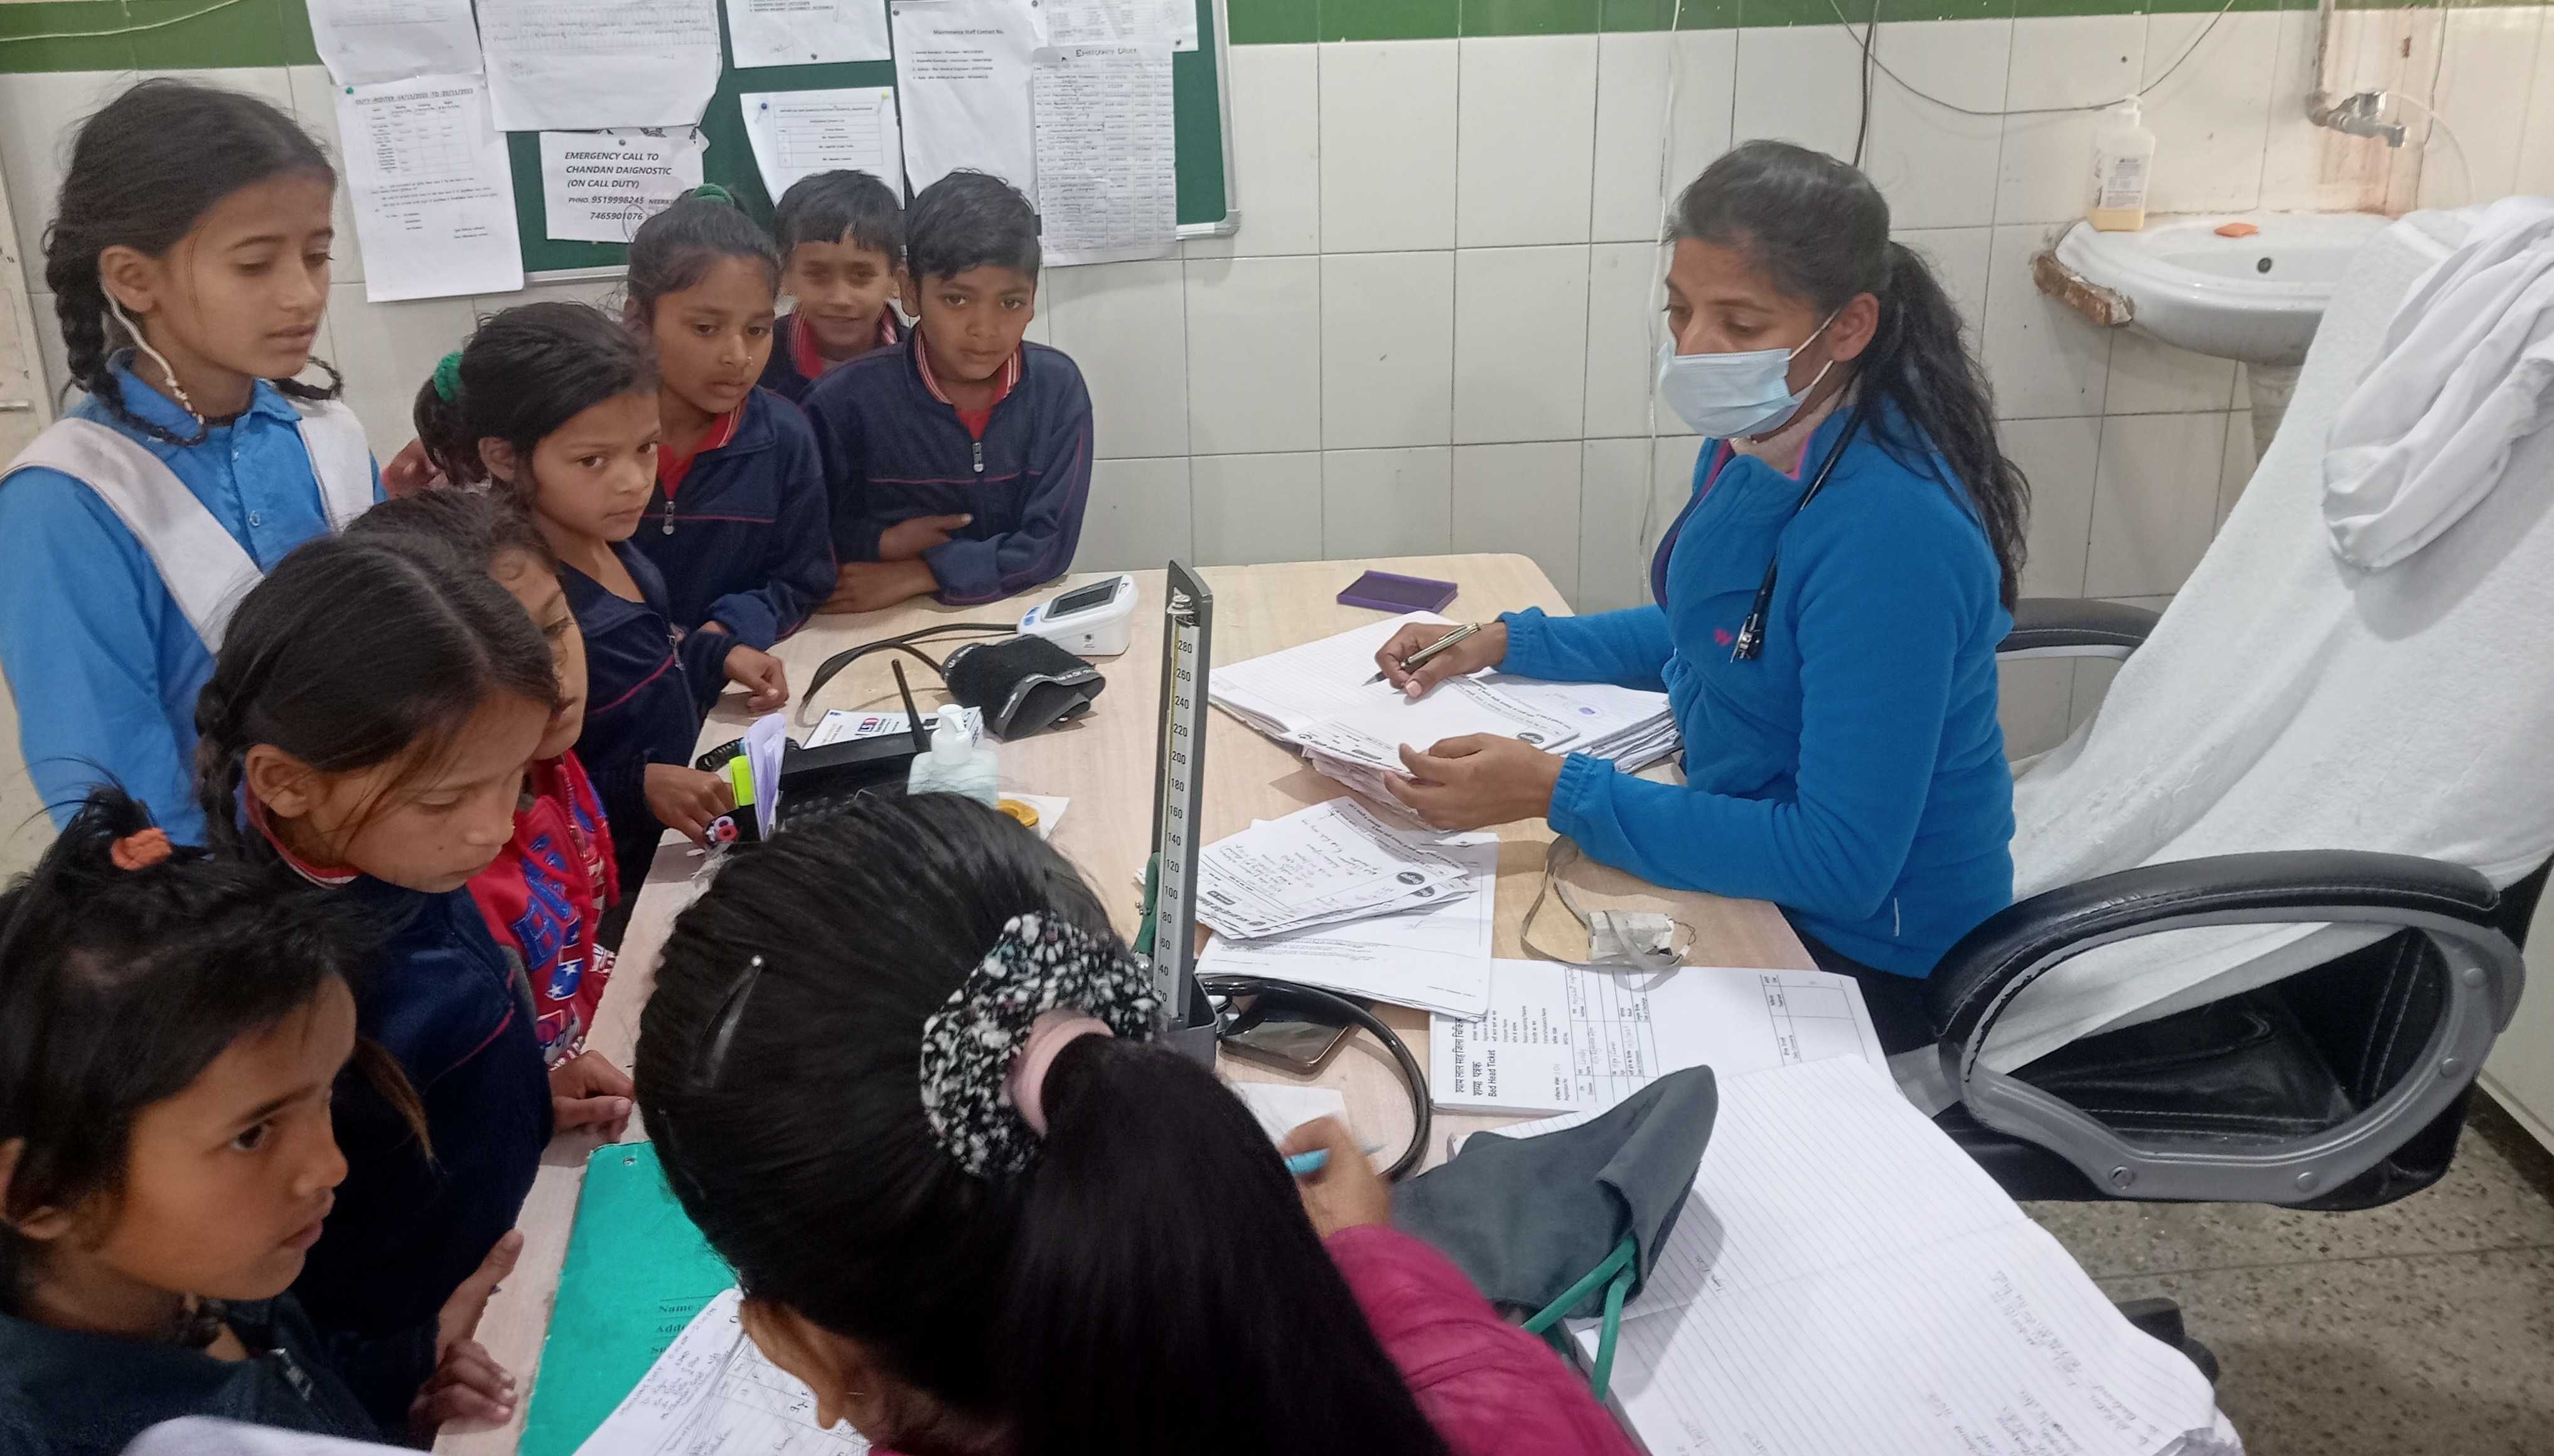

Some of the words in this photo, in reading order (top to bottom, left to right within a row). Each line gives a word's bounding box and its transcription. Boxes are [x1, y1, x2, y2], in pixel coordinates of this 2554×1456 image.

[565, 152, 621, 160] EMERGENCY
[622, 153, 644, 161] CALL
[566, 166, 613, 174] CHANDAN
[616, 166, 672, 175] DAIGNOSTIC
[567, 179, 585, 188] (ON
[611, 180, 639, 188] DUTY)
[591, 196, 644, 204] 9519998245
[1178, 640, 1192, 653] 280
[1177, 668, 1191, 682] 260
[1175, 695, 1189, 709] 240
[1173, 724, 1188, 737] 220
[1172, 751, 1186, 764] 200
[1171, 778, 1184, 792] 180
[1169, 805, 1183, 819] 160
[1167, 832, 1181, 846] 140
[1166, 859, 1179, 873] 120
[1164, 885, 1178, 899] 100
[1162, 911, 1172, 923] 80
[1161, 938, 1170, 950] 60
[1159, 964, 1169, 976] 40
[1486, 1050, 1495, 1067] Ticket
[1487, 1069, 1496, 1084] Head
[1487, 1086, 1497, 1097] Bed
